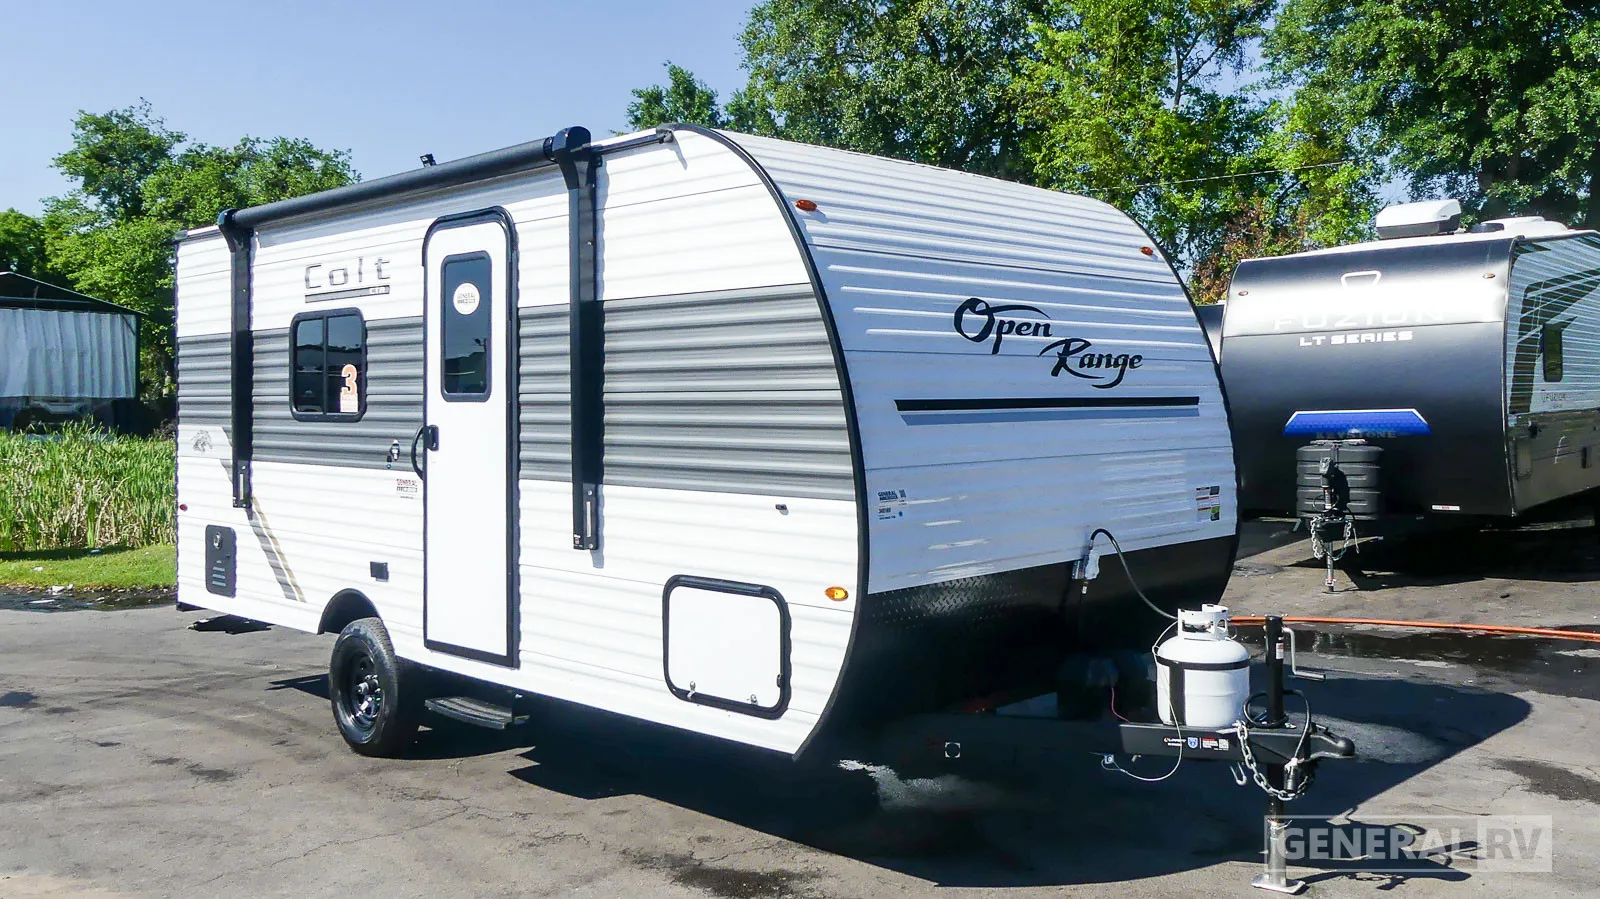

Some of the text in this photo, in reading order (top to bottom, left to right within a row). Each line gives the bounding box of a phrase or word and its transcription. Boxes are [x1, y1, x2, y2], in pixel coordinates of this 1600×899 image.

[304, 256, 391, 289] Colt
[954, 297, 1053, 354] Open
[1299, 330, 1413, 346] LT SERIES
[341, 364, 358, 395] 3
[1036, 337, 1144, 389] Range
